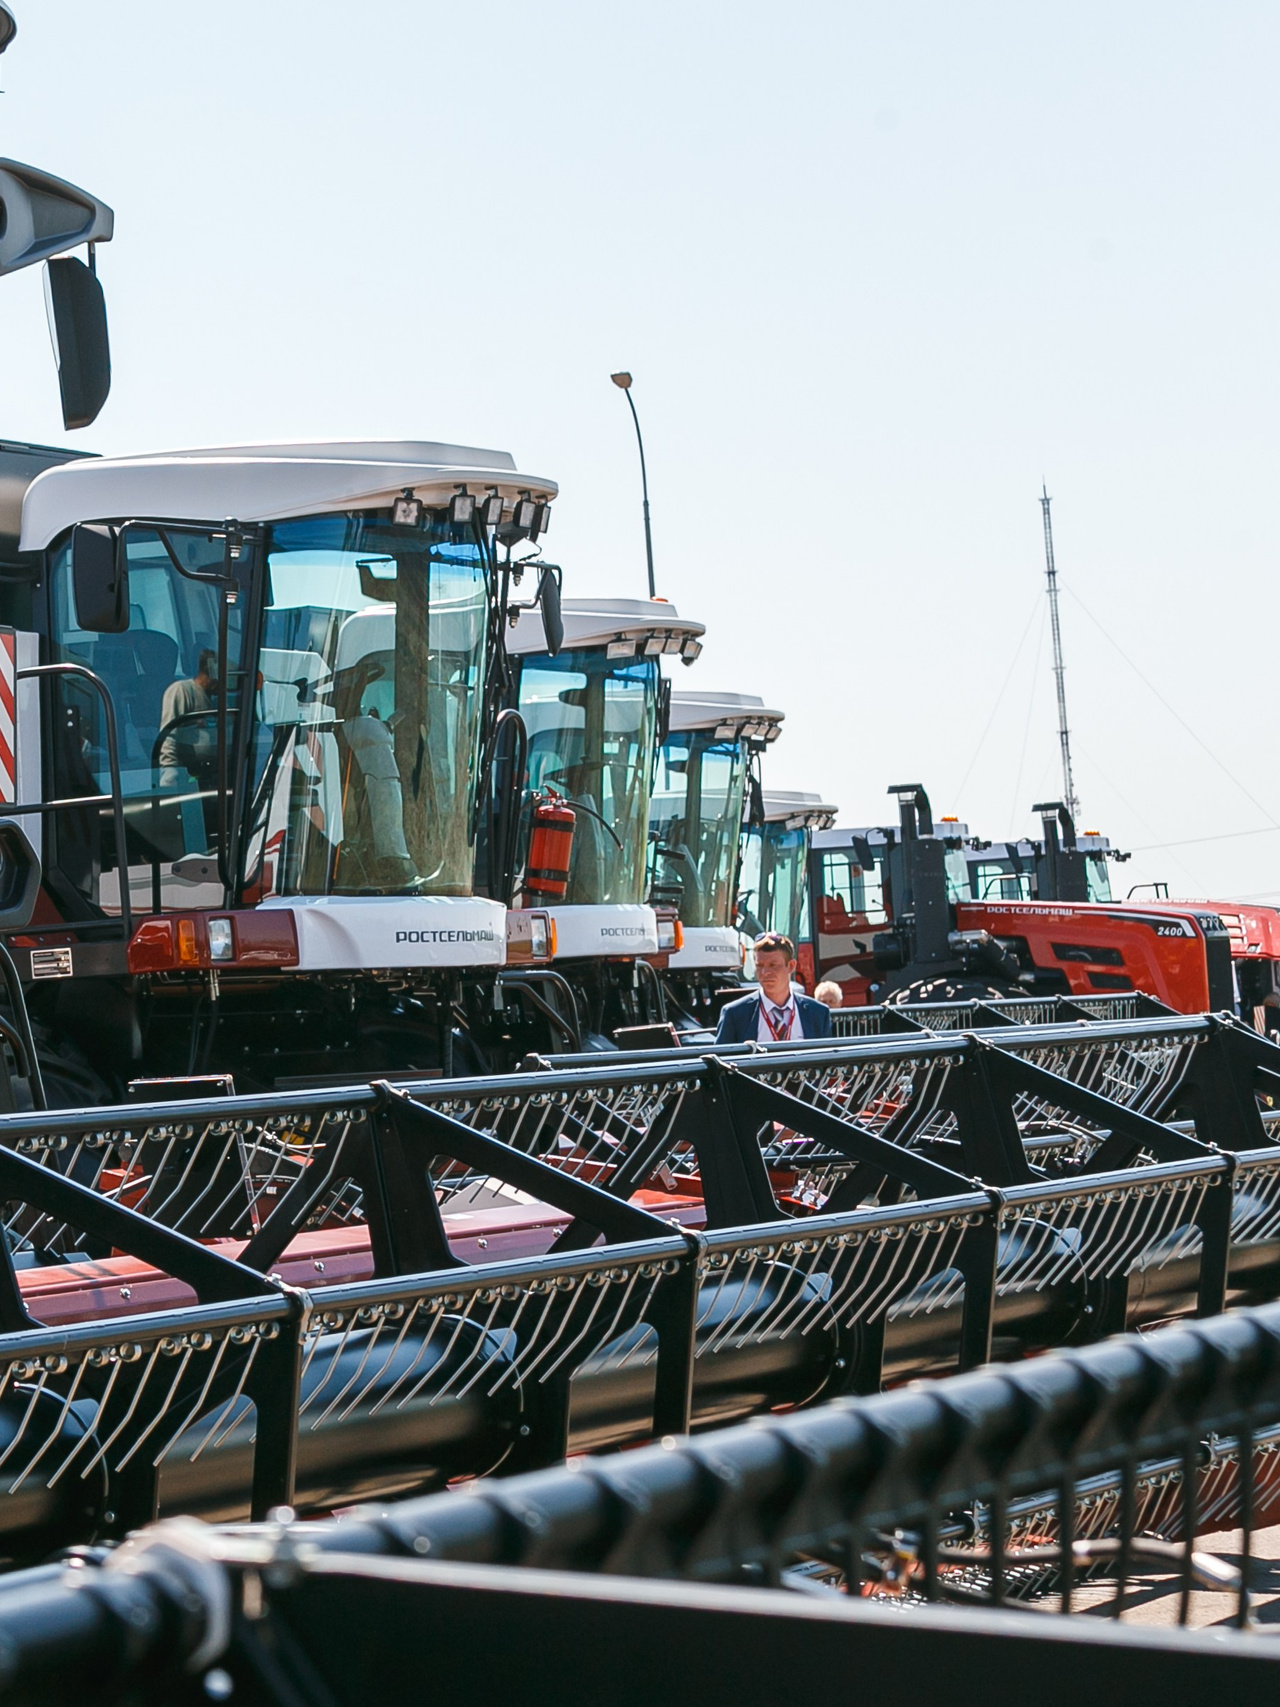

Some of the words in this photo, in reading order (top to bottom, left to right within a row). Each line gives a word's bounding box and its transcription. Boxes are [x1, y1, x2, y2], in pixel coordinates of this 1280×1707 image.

[986, 906, 1072, 915] РОСТСЕЛЬМАШ
[600, 927, 654, 937] РОСТСЕЛЬ
[1157, 926, 1183, 936] 2400
[395, 930, 494, 943] РОСТСЕЛЬМАШ
